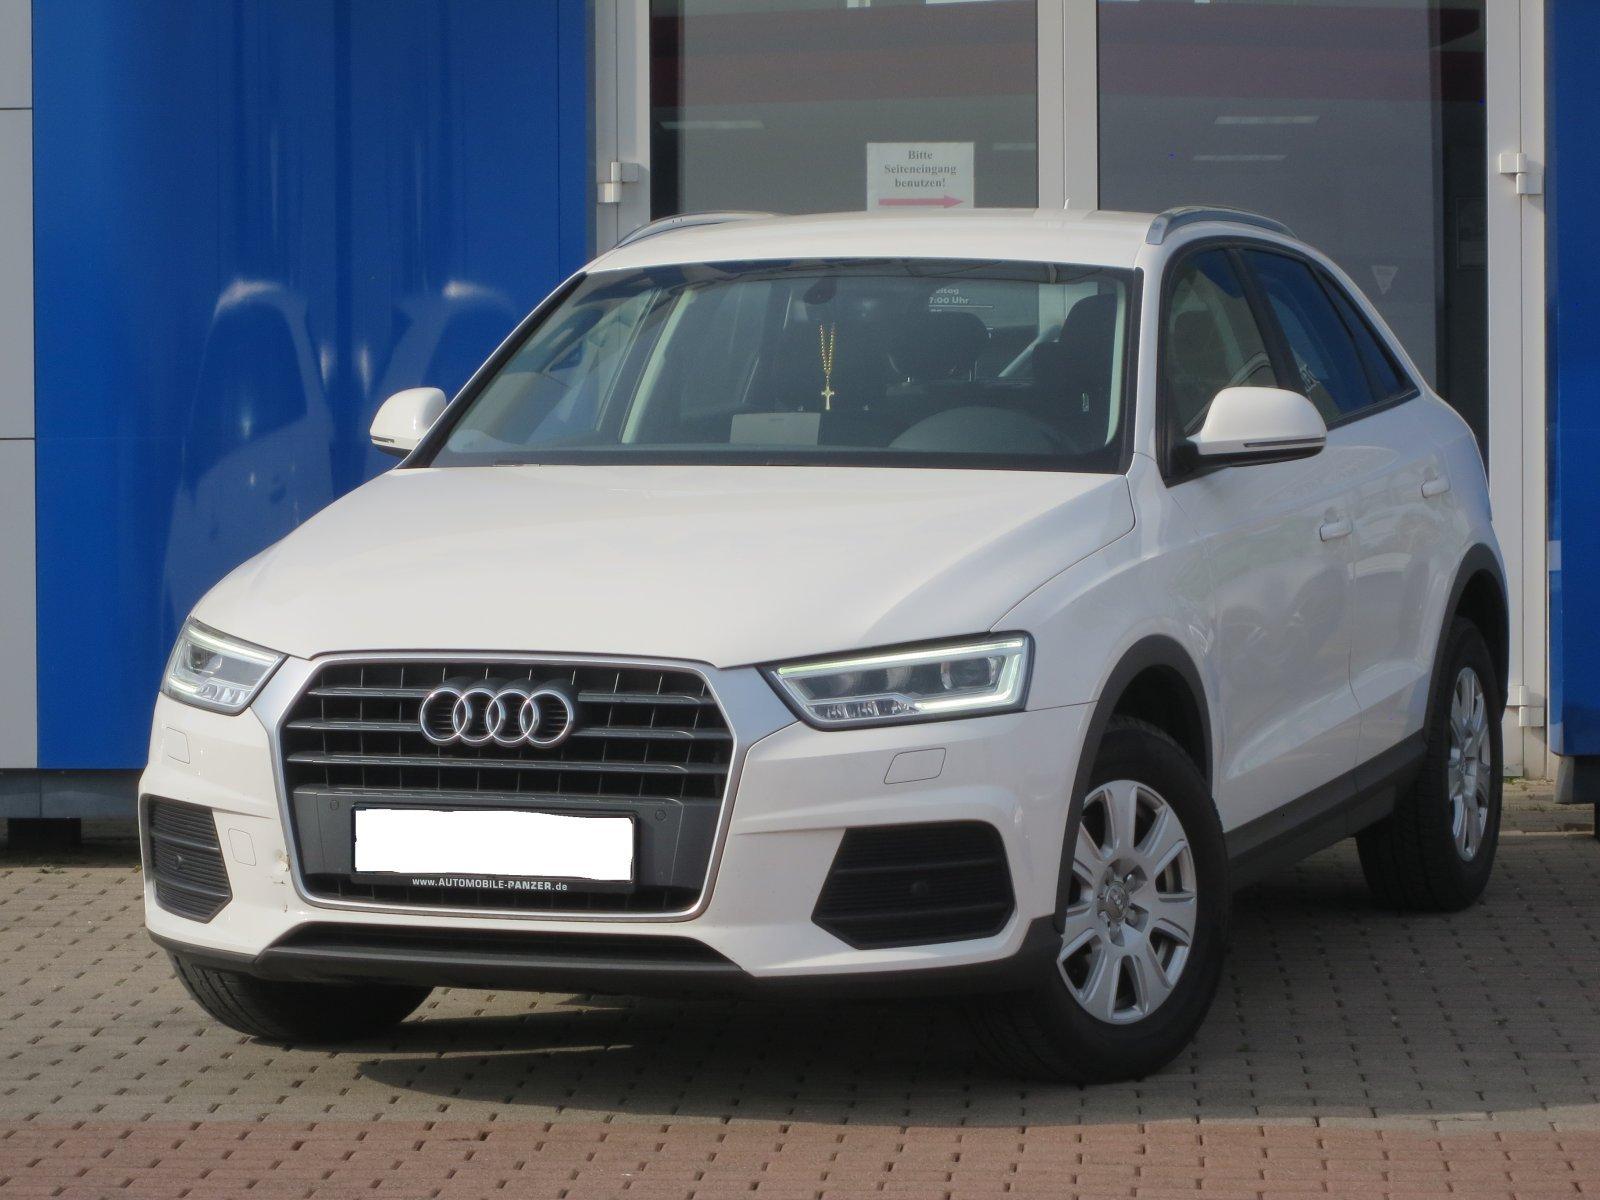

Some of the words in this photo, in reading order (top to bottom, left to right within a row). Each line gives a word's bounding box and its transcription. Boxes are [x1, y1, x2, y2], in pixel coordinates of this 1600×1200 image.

[908, 150, 934, 160] Bitte
[884, 163, 957, 175] Seiteneingang
[894, 178, 946, 188] benutzen!
[953, 296, 969, 305] Uhr
[412, 877, 568, 891] www.AUTOMOBILE-PANZER.de
